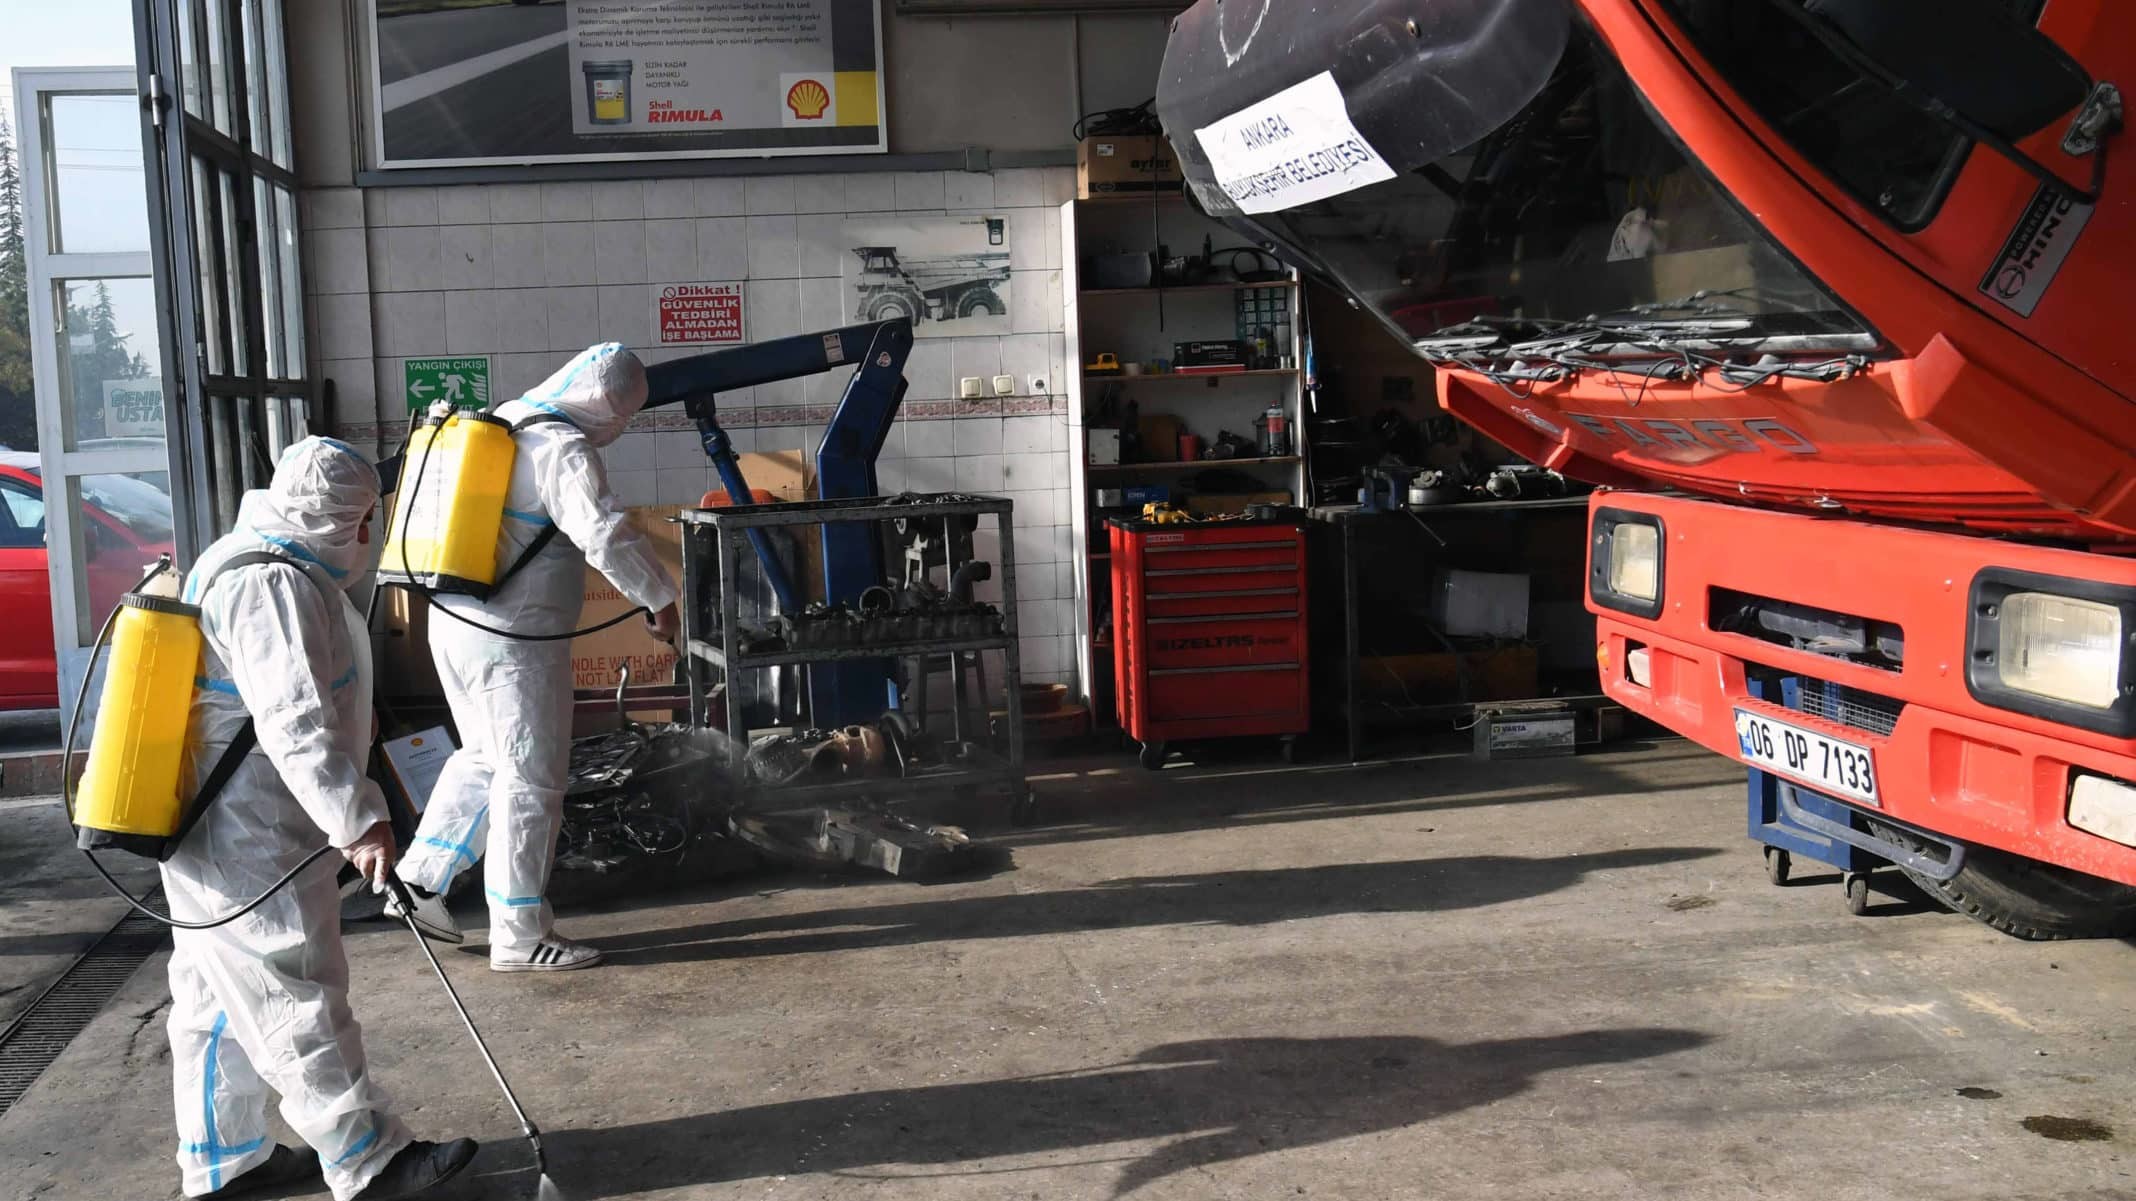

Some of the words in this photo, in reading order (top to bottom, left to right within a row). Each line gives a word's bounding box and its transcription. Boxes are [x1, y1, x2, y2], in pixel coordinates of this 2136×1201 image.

[649, 100, 672, 110] Shell
[648, 109, 723, 123] RIMULA
[1241, 113, 1294, 152] ANKARA
[678, 285, 730, 296] Dikkat
[662, 298, 739, 309] GÜVENLİK
[671, 309, 731, 320] TEDBİRİ
[665, 319, 738, 329] ALMADAN
[663, 330, 681, 341] İŞE
[685, 330, 740, 341] BAŞLAMA
[408, 361, 450, 371] YANGIN
[1567, 413, 1817, 454] FARGO
[577, 672, 602, 685] NOT
[635, 669, 664, 682] FLAT
[1503, 725, 1527, 733] VARTA
[1750, 719, 1775, 760] 06
[1785, 730, 1808, 771] DP
[1818, 741, 1873, 794] 7133
